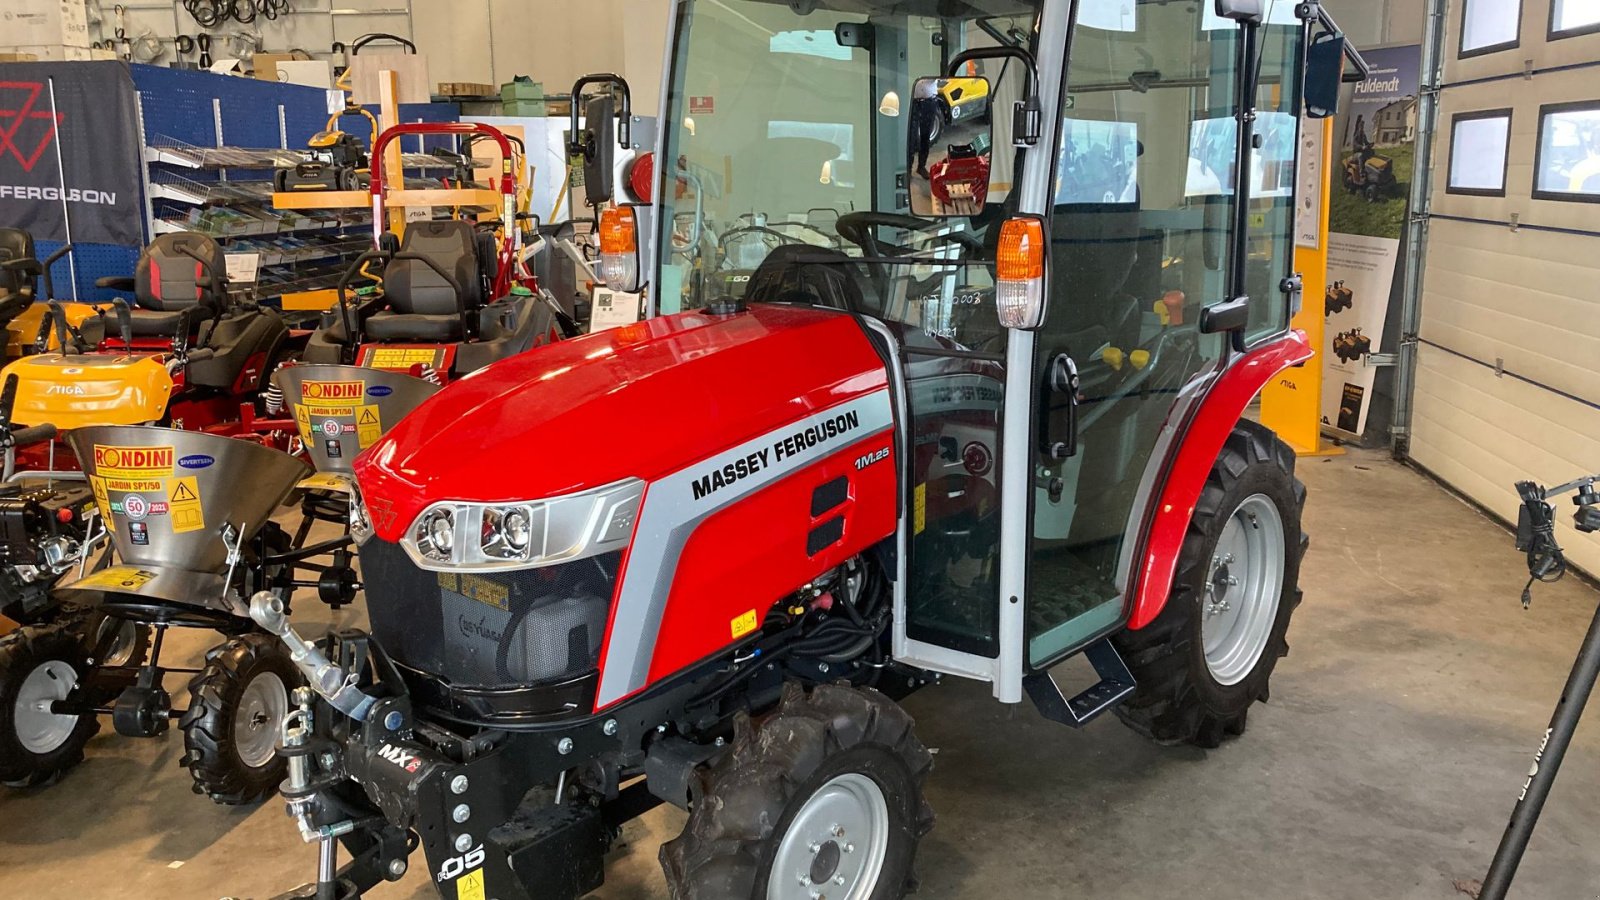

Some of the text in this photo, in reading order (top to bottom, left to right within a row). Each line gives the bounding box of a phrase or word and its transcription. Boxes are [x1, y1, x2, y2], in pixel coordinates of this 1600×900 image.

[1354, 76, 1399, 94] Fuldendt
[0, 185, 116, 205] FERGUSON
[46, 385, 84, 395] STIGA
[302, 383, 362, 398] RONDINI
[1280, 379, 1297, 391] STIGA
[325, 424, 337, 432] 50
[95, 448, 173, 468] RONDINI
[691, 409, 859, 500] MASSEY FERGUSON
[854, 447, 890, 470] 1M.25
[108, 480, 161, 490] JARDIN SPT/50
[127, 501, 143, 512] 50
[377, 743, 415, 768] MX
